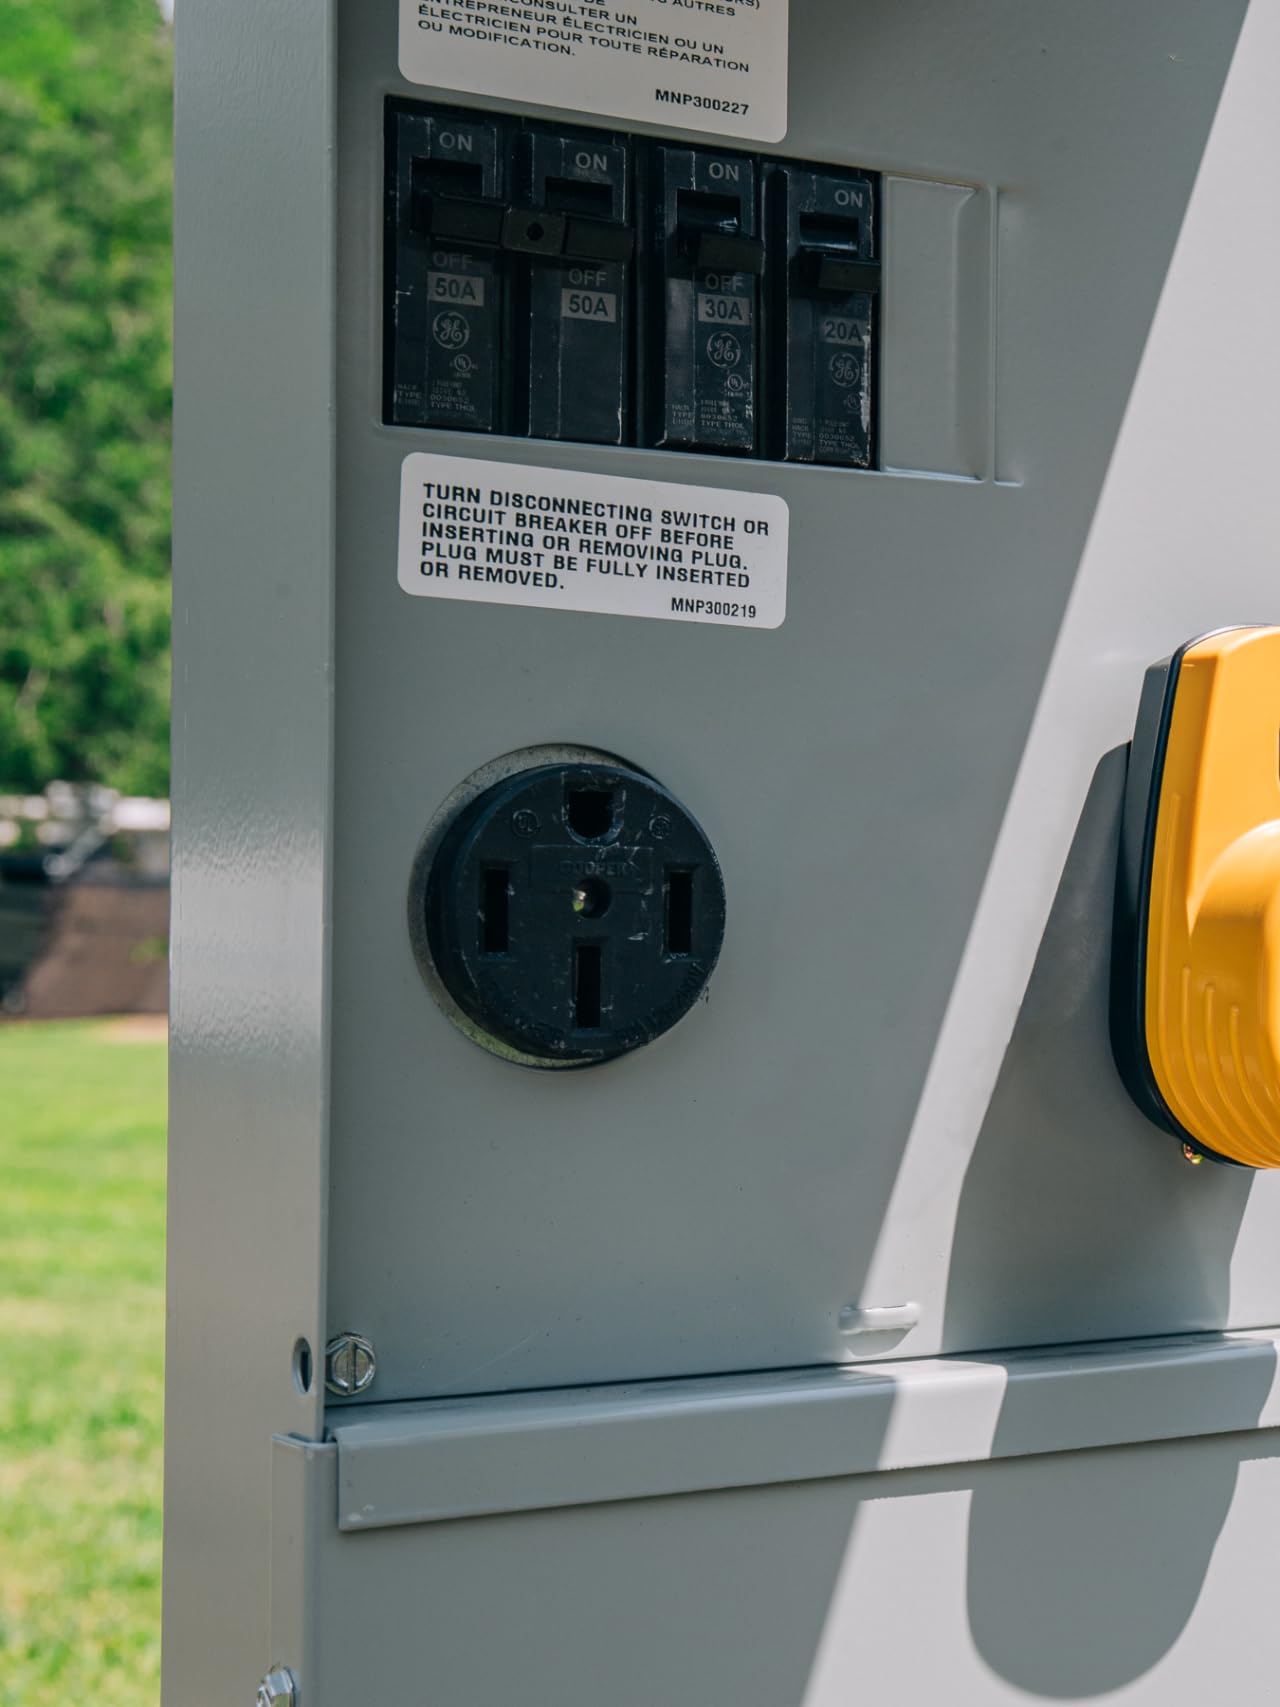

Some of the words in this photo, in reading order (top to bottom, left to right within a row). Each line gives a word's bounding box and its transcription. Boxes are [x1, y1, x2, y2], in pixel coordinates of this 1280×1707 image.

[615, 12, 637, 26] UN
[672, 0, 736, 16] AUTRES
[418, 3, 531, 34] ÉLECTRICIEN
[536, 26, 583, 44] POUR
[588, 36, 642, 54] TOUTE
[647, 46, 749, 73] RÉPARATION
[418, 20, 443, 32] OU
[449, 25, 575, 56] MODIFICATION.
[421, 0, 557, 25] REPRENEUR
[562, 15, 669, 45] ÉLECTRICIEN
[674, 38, 697, 50] OU
[702, 42, 724, 55] UN
[655, 88, 749, 115] MNP300227
[439, 132, 473, 152] ON
[575, 152, 608, 171] ON
[708, 162, 739, 181] ON
[834, 189, 863, 208] ON
[432, 251, 473, 270] OFF
[568, 268, 608, 287] OFF
[704, 272, 744, 292] OFF
[435, 278, 476, 300] 50A
[568, 295, 608, 317] 50A
[705, 298, 743, 321] 30A
[826, 320, 862, 341] 20A
[423, 482, 481, 504] TURN
[490, 489, 652, 523] DISCONNECTING
[660, 510, 735, 532] SWITCH
[743, 520, 769, 536] OR
[422, 502, 507, 526] CIRCUIT
[515, 512, 607, 537] BREAKER
[615, 524, 652, 541] OFF
[660, 528, 734, 550] BEFORE
[422, 521, 534, 548] INSERTING
[542, 535, 570, 552] OR
[579, 538, 683, 564] REMOVING
[691, 550, 748, 570] PLUG.
[420, 561, 449, 578] OR
[458, 563, 564, 589] REMOVED.
[421, 540, 477, 562] PLUG
[486, 547, 545, 568] MUST
[553, 554, 578, 571] BE
[586, 557, 648, 578] FULLY
[656, 565, 750, 588] INSERTED
[671, 597, 756, 618] MNP300219
